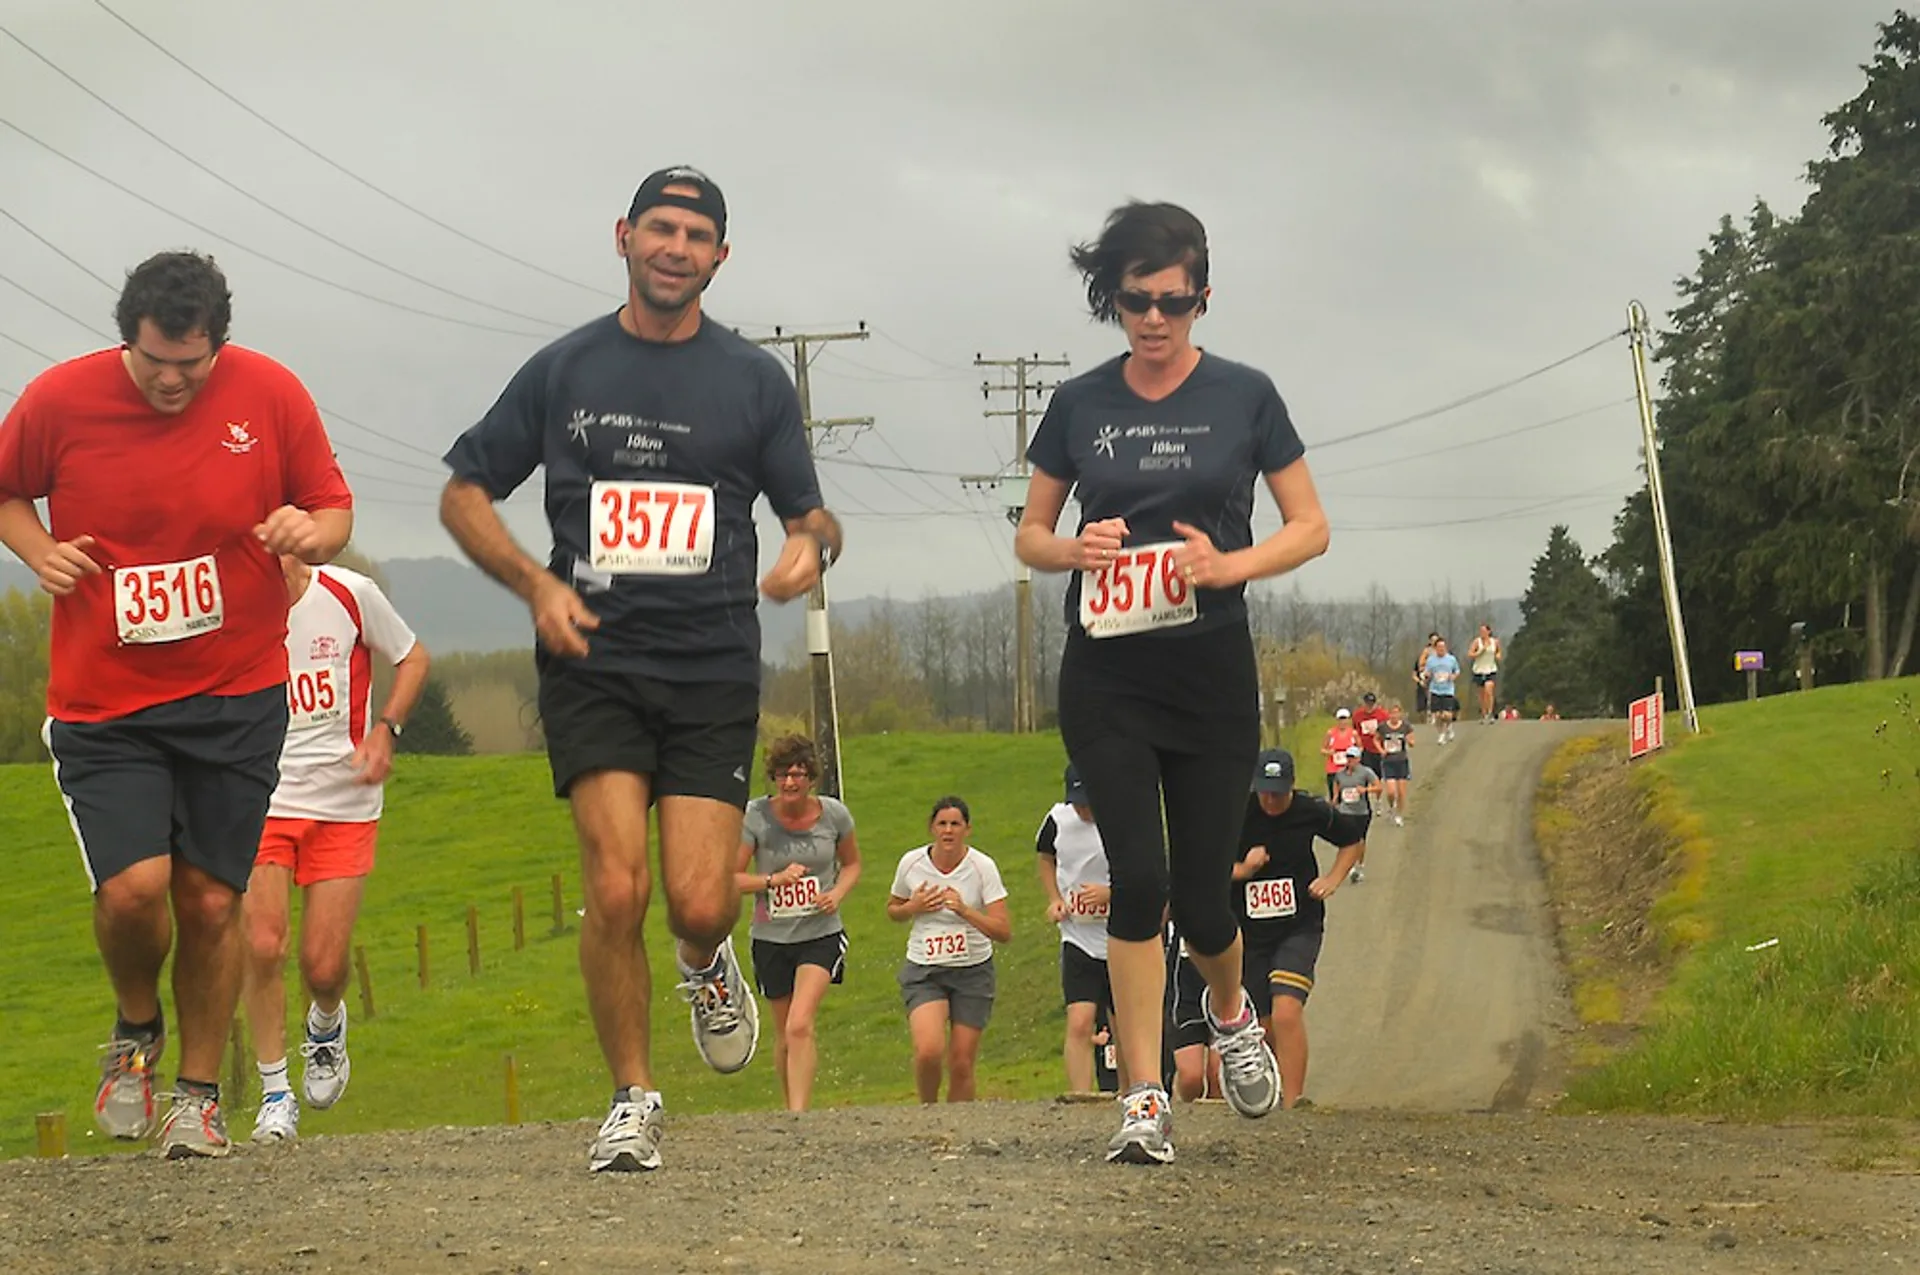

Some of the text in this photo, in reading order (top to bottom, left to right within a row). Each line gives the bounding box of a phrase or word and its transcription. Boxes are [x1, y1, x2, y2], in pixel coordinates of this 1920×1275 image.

[626, 434, 663, 450] 10km
[1151, 441, 1185, 455] 10km
[600, 489, 706, 550] 3577
[665, 554, 708, 568] HAMILTON
[124, 562, 215, 625] 3516
[1089, 549, 1186, 616] 3576
[1151, 607, 1194, 622] HAMILTON
[773, 879, 816, 907] 3568
[1250, 881, 1291, 909] 3468
[925, 934, 966, 956] 3732
